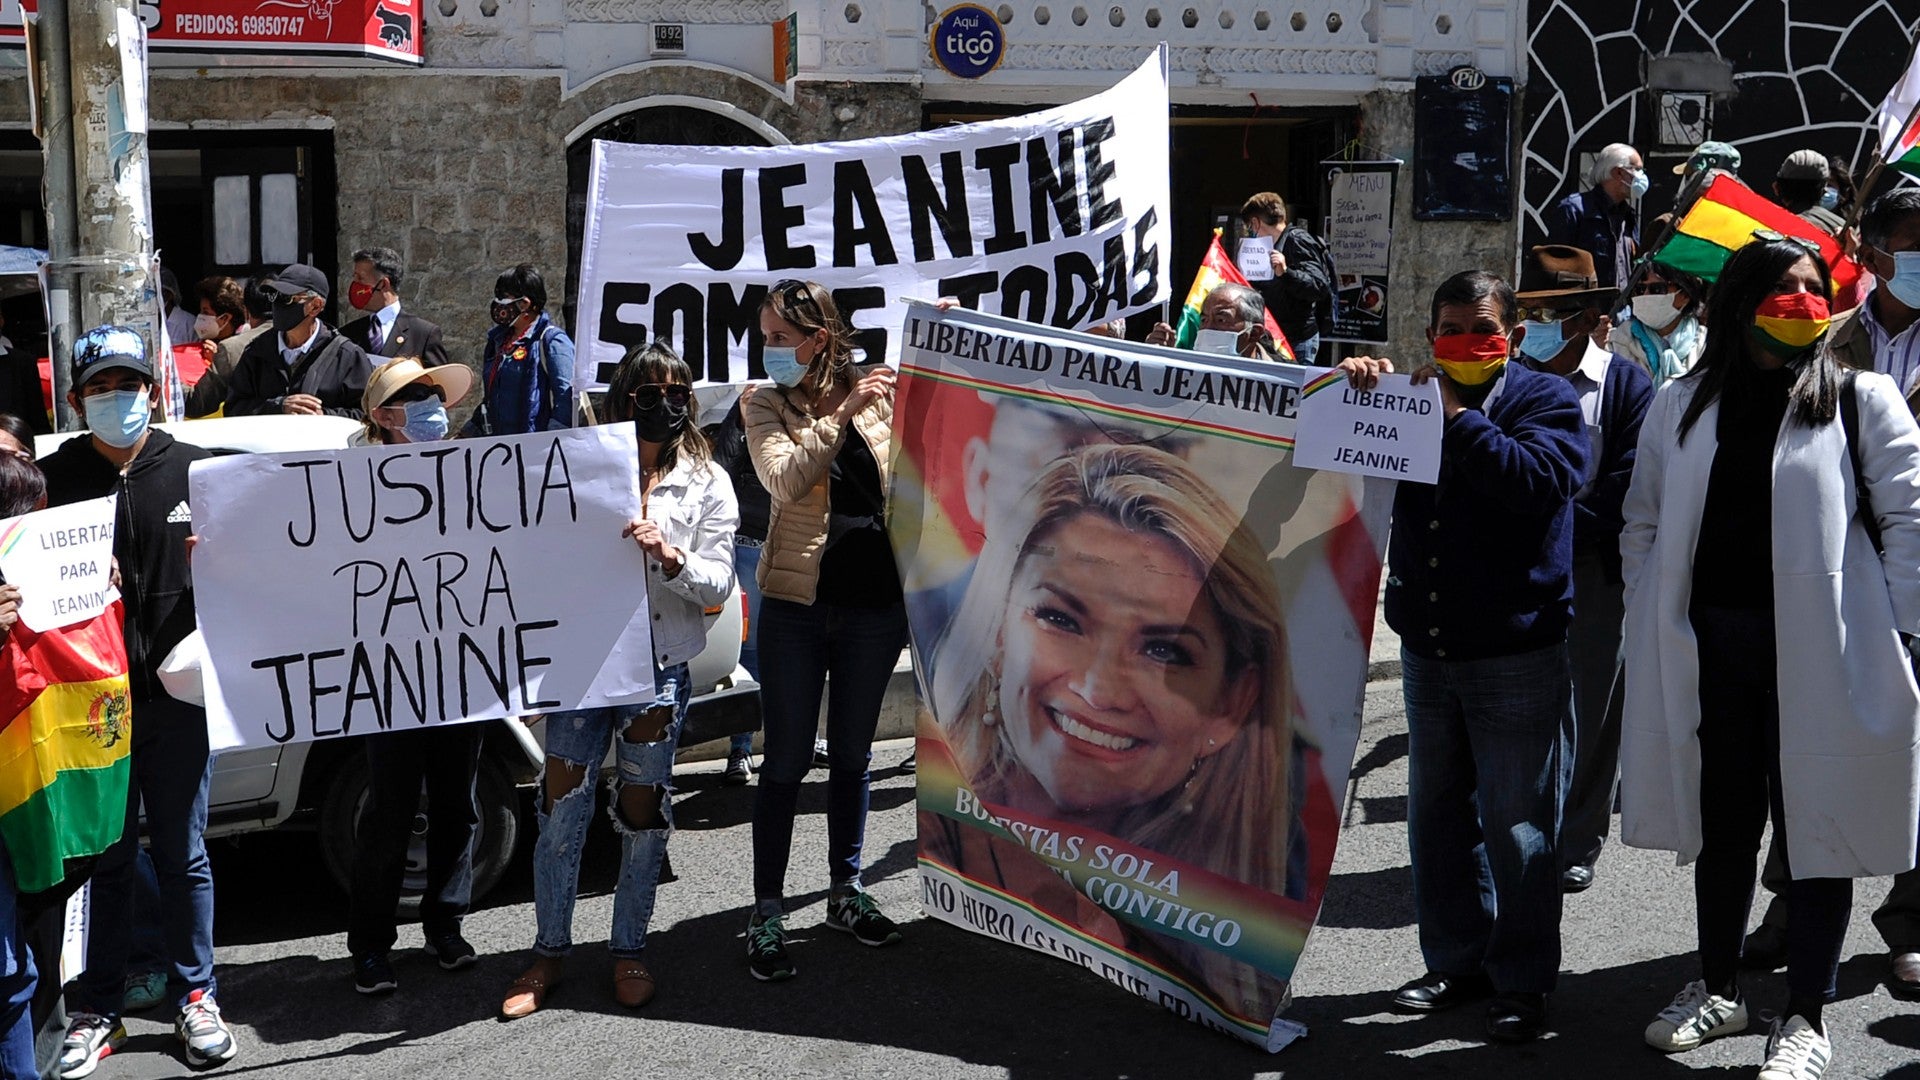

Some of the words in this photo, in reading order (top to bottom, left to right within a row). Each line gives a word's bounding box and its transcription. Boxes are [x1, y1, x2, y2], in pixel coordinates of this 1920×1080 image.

[175, 14, 239, 35] PEDIDOS:
[241, 16, 305, 36] 69850747
[656, 26, 681, 39] 1892
[952, 14, 979, 31] Aquí
[1456, 70, 1479, 87] Pil
[686, 115, 1124, 272] JEANINE
[1349, 174, 1385, 193] MENU
[595, 281, 888, 385] SOMS
[938, 205, 1160, 331] TODAS
[908, 318, 1053, 373] LIBERTAD
[1061, 346, 1144, 392] PARA
[1153, 365, 1301, 420] JEANINE
[1342, 388, 1432, 416] LIBERTAD
[1353, 421, 1399, 442] PARA
[1333, 446, 1410, 473] JEANINE
[281, 436, 578, 548] JUSTICIA
[166, 513, 192, 524] adida
[60, 559, 98, 581] PARA
[52, 590, 107, 616] JEANIN
[332, 546, 517, 638] PARA
[250, 619, 561, 744] JEANINE
[1088, 844, 1180, 897] SOLA
[922, 875, 955, 913] NO
[1085, 876, 1242, 948] CONTIGO
